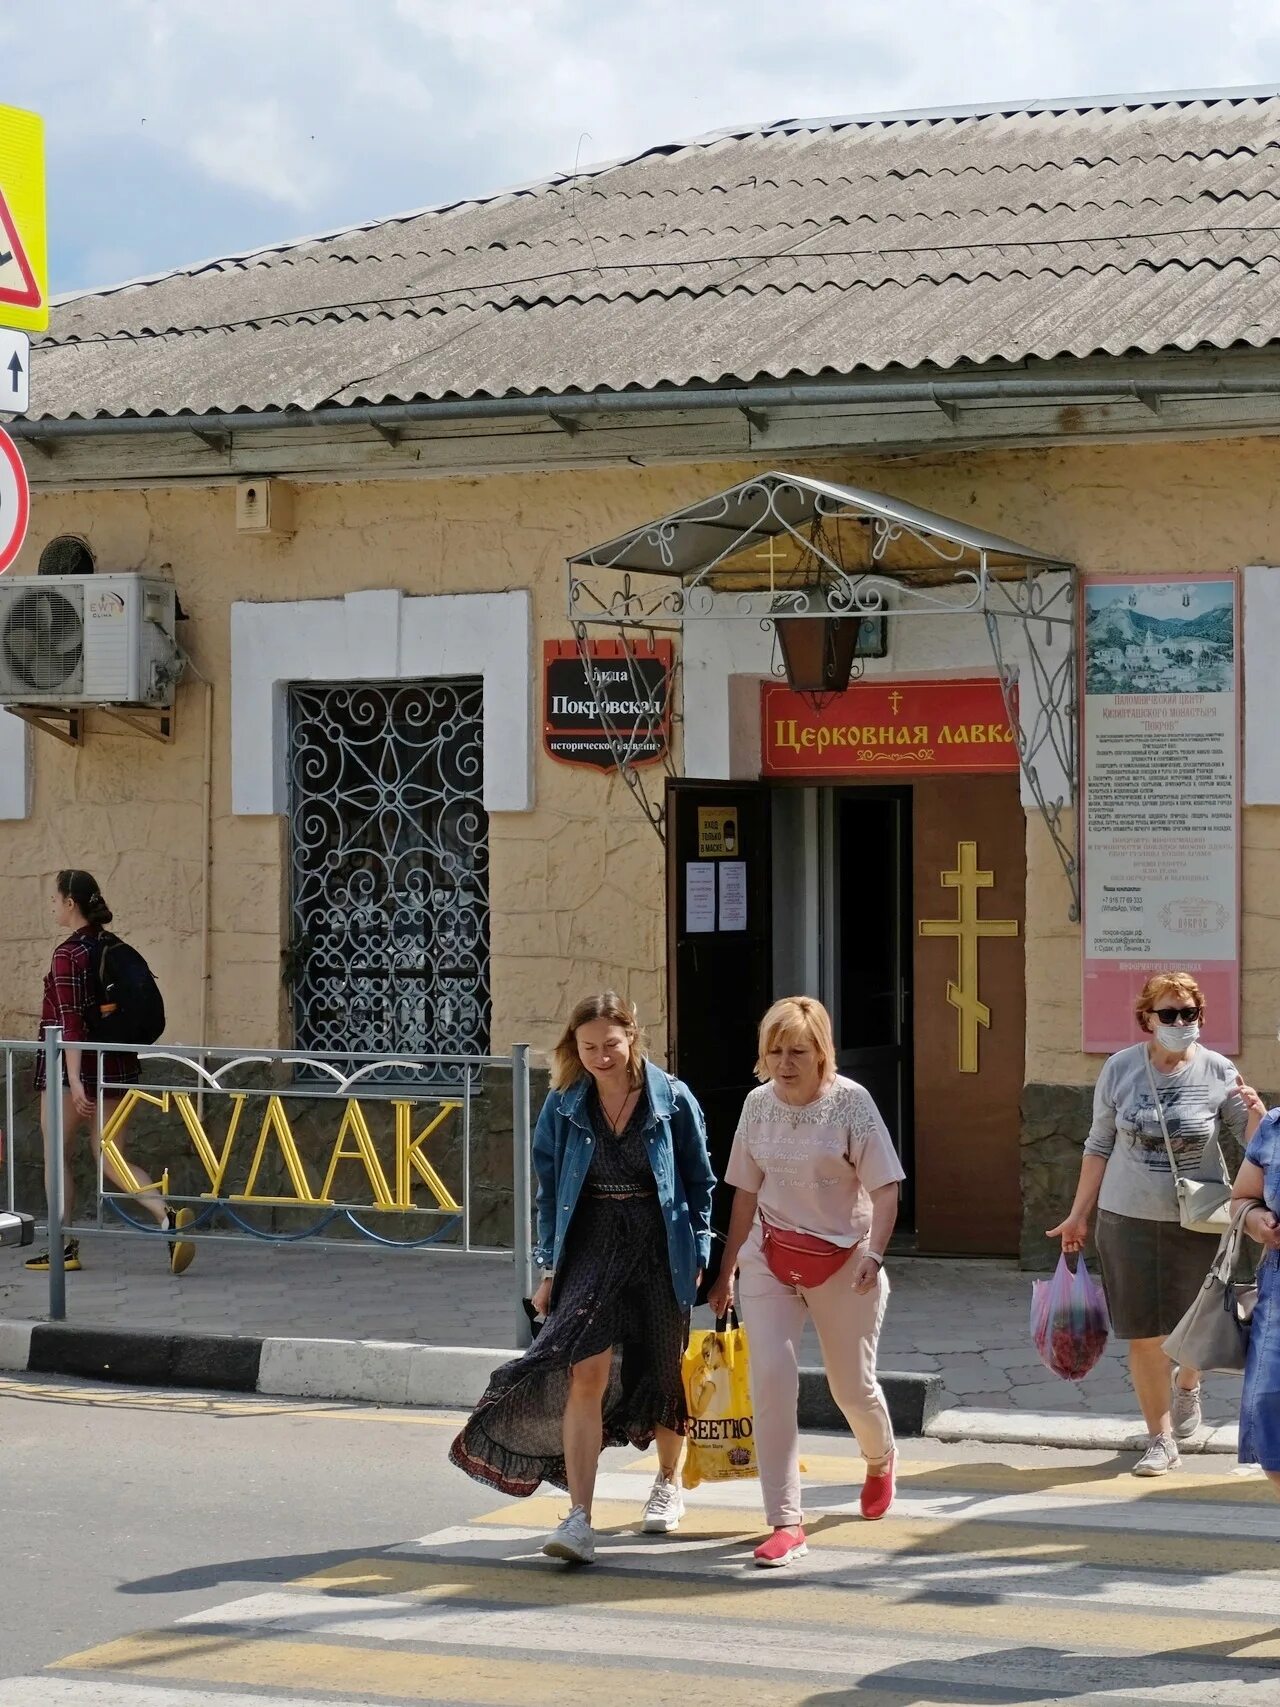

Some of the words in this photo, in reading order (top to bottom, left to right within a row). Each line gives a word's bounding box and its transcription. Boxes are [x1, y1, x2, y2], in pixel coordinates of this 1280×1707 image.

[584, 671, 628, 685] улица
[552, 696, 661, 719] Покровская
[551, 742, 613, 752] историческо
[775, 720, 928, 754] Церковная
[937, 724, 1018, 744] лавка
[686, 1416, 754, 1440] BEETHO
